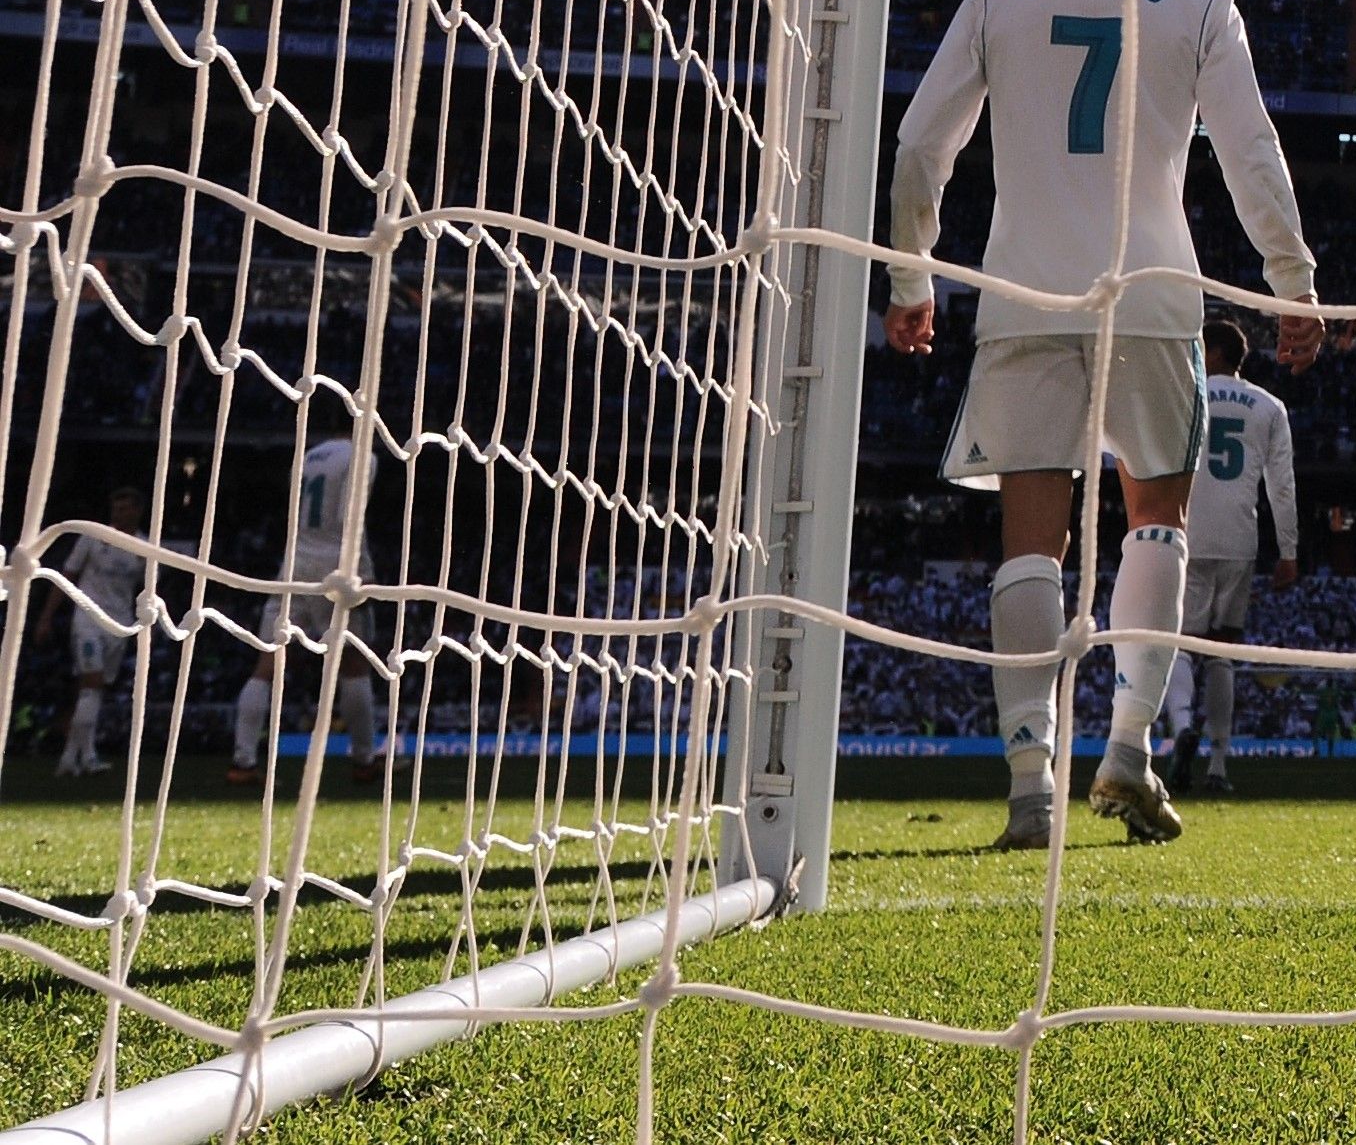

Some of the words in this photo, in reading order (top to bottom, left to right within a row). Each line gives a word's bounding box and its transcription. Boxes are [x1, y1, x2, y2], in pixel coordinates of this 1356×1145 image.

[1050, 15, 1123, 154] 7
[1209, 389, 1257, 409] ARANE
[1208, 416, 1245, 480] 5
